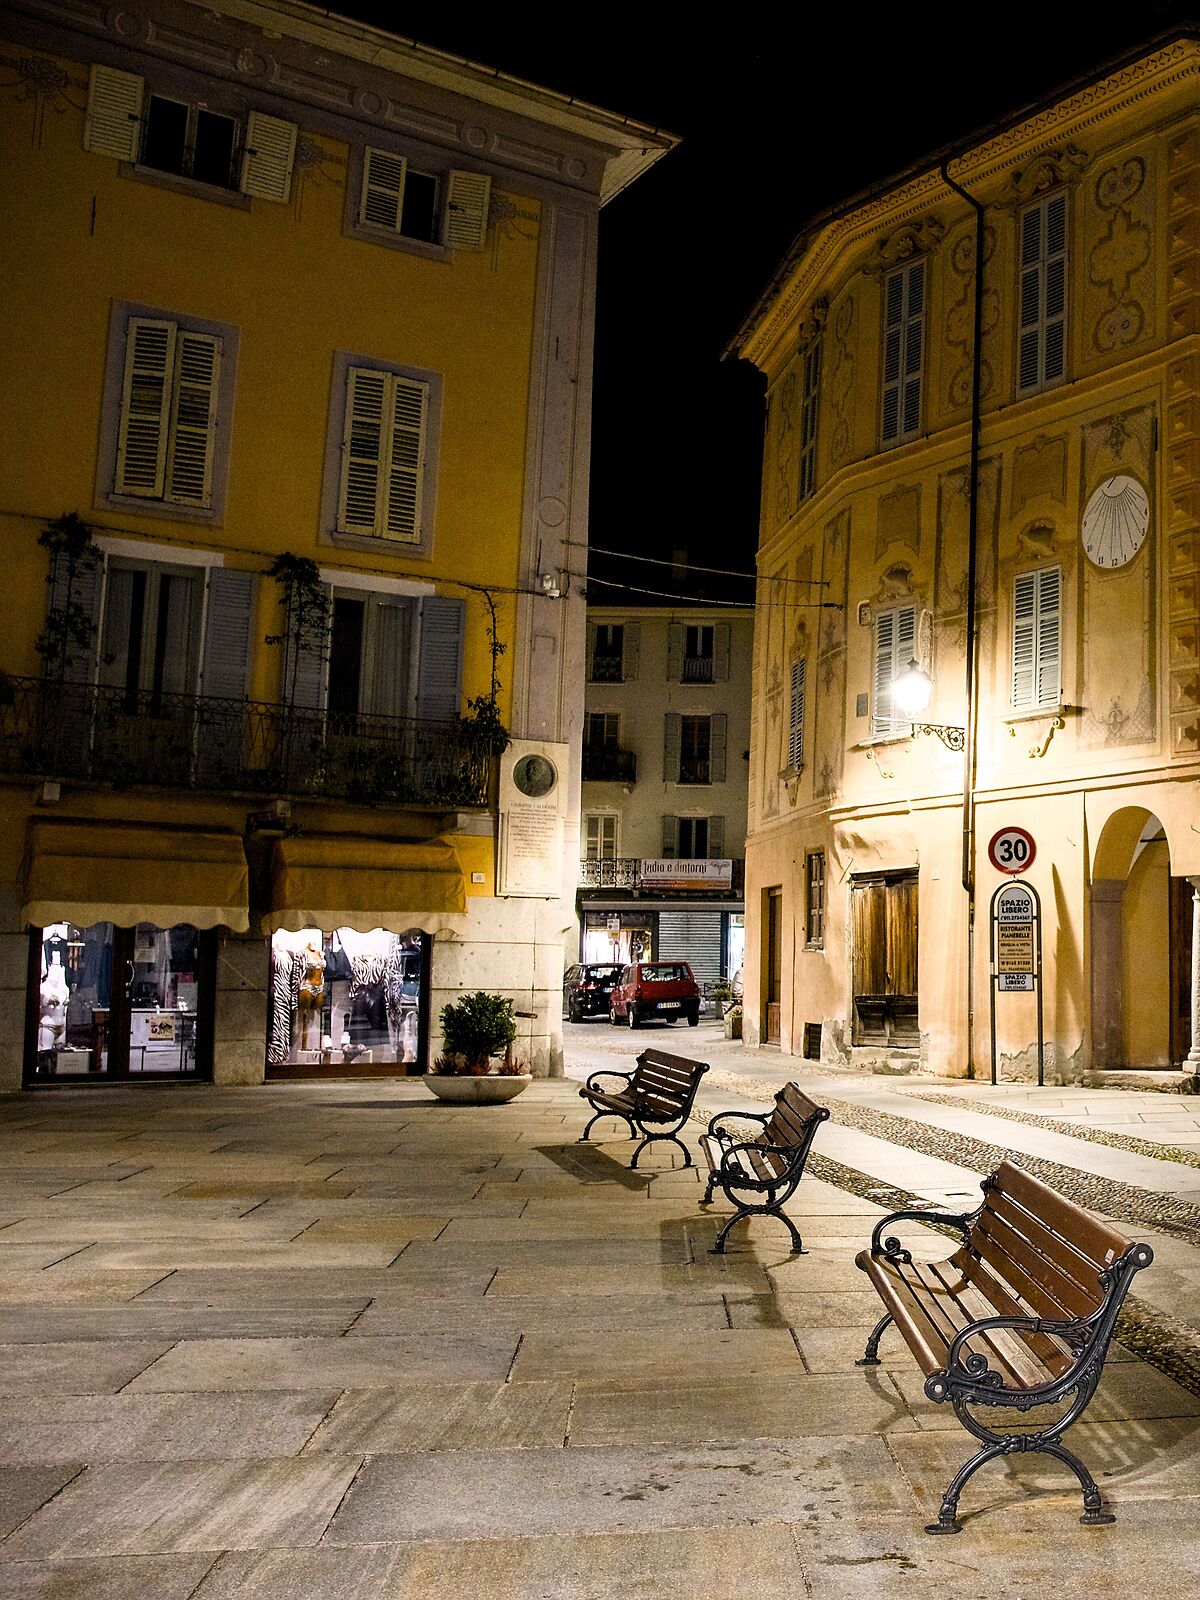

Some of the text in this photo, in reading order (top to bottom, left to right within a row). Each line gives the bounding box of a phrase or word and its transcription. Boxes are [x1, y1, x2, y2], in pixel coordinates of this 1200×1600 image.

[1142, 528, 1145, 536] 3
[1087, 545, 1093, 553] 10
[1134, 542, 1138, 550] 2
[1098, 556, 1104, 565] 11
[1123, 554, 1127, 562] 1
[1111, 558, 1118, 567] 12
[999, 838, 1027, 862] 30
[667, 864, 672, 872] e
[674, 861, 707, 874] dintorni
